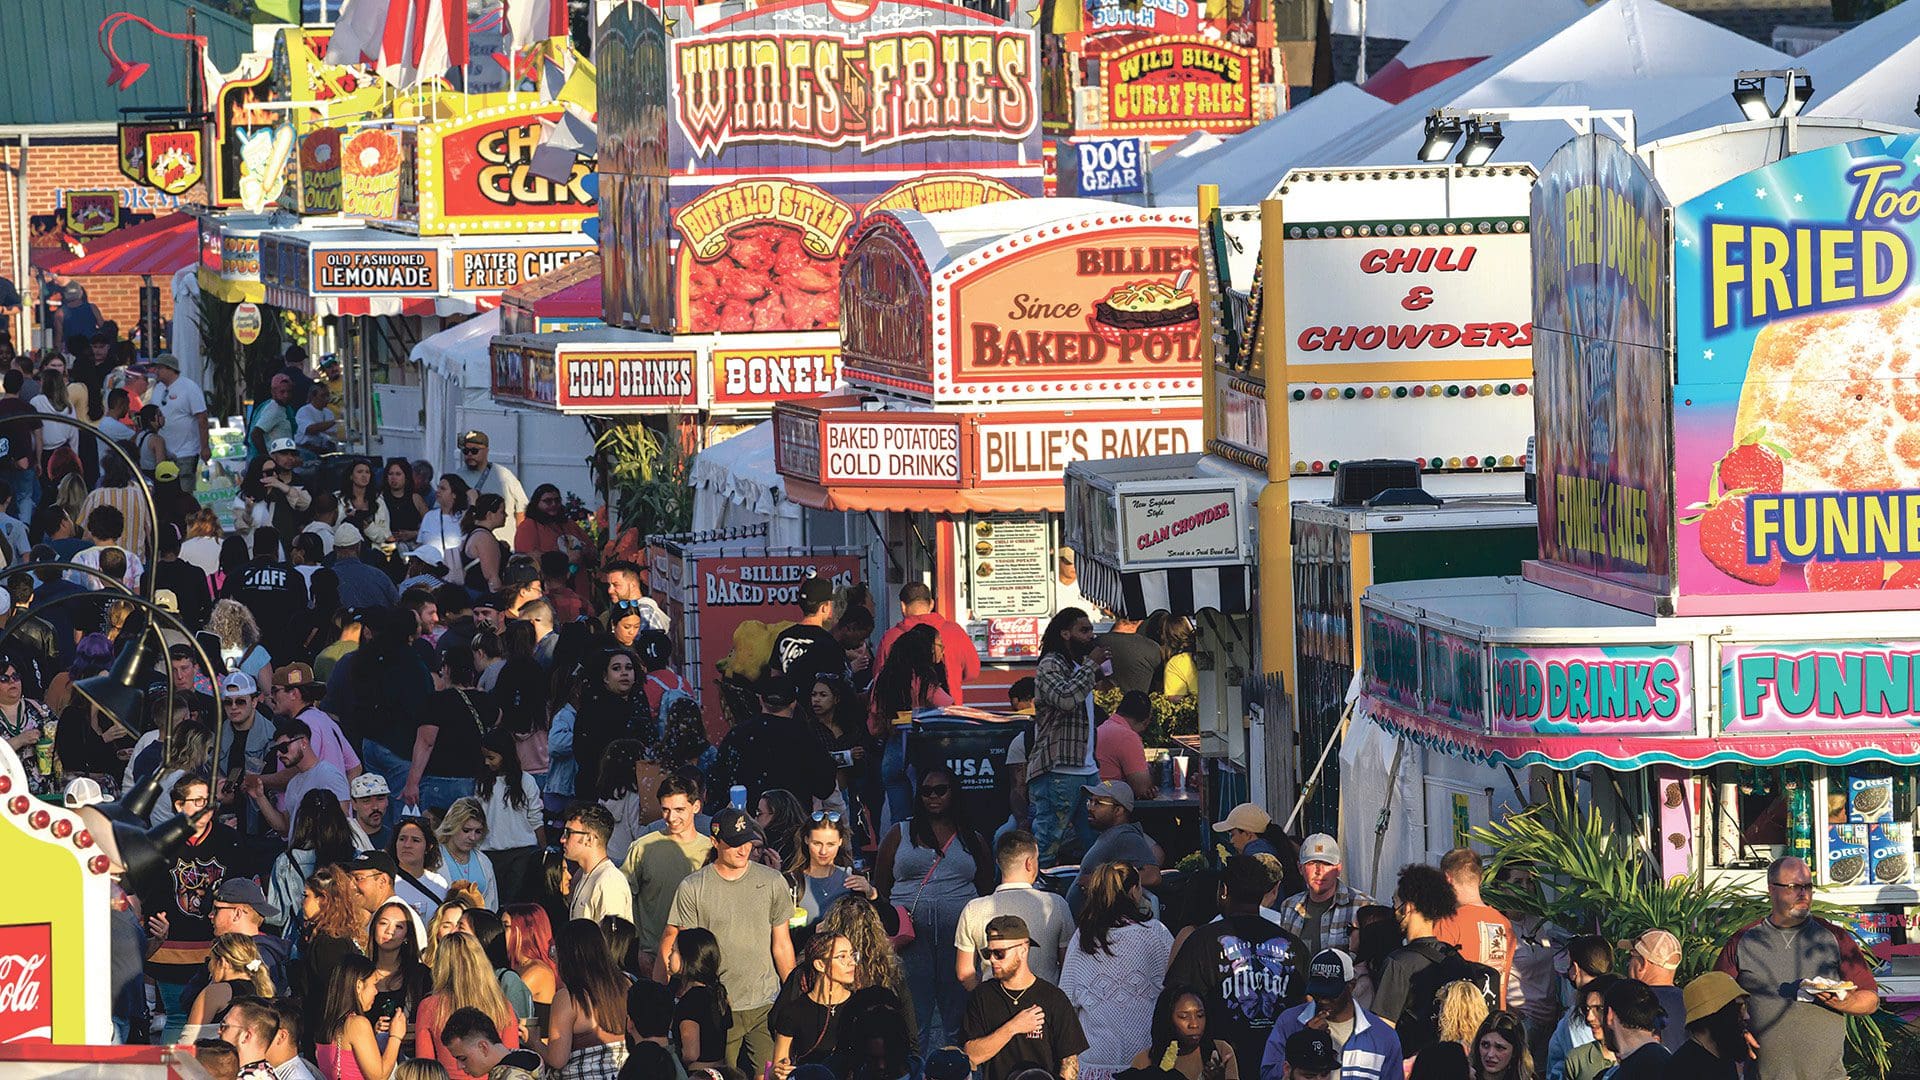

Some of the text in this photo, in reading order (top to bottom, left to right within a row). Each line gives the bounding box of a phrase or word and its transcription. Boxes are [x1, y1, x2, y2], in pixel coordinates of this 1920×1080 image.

[1118, 48, 1243, 84] WILD BILL'S
[682, 37, 841, 134] WINGS
[867, 36, 1027, 135] FRIES
[1114, 82, 1246, 118] CURLY FRIES
[1079, 141, 1137, 172] DOG
[1081, 169, 1137, 190] GEAR
[343, 189, 398, 218] ONION
[683, 184, 849, 243] BUFFALO STYLE
[327, 253, 425, 267] OLD FASHIONED
[463, 253, 517, 270] BATTER
[1359, 246, 1478, 274] CHILI
[1566, 185, 1603, 272] FRIED
[1606, 187, 1658, 321] DOUGH
[321, 266, 432, 288] LEMONADE
[463, 269, 518, 286] FRIED
[1711, 223, 1909, 329] FRIED
[1008, 293, 1082, 321] Since
[1400, 285, 1434, 312] &
[971, 321, 1108, 368] BAKED
[1297, 321, 1533, 352] CHOWDERS
[568, 358, 692, 398] COLD DRINKS
[830, 427, 958, 451] BAKED POTATOES
[986, 427, 1189, 473] BILLIE'S BAKED
[830, 454, 958, 477] COLD DRINKS
[1132, 497, 1176, 509] New England
[1146, 509, 1165, 518] Style
[1136, 501, 1231, 551] CLAM CHOWDER
[1556, 473, 1649, 567] FUNNEL CAKES
[739, 564, 818, 582] BILLIE'S
[705, 571, 765, 606] BAKED
[1548, 659, 1679, 720] DRINKS
[1740, 652, 1920, 718] FUNN
[1852, 777, 1892, 791] OREO
[1829, 847, 1866, 860] OREO
[1311, 962, 1342, 975] PATRIOTS
